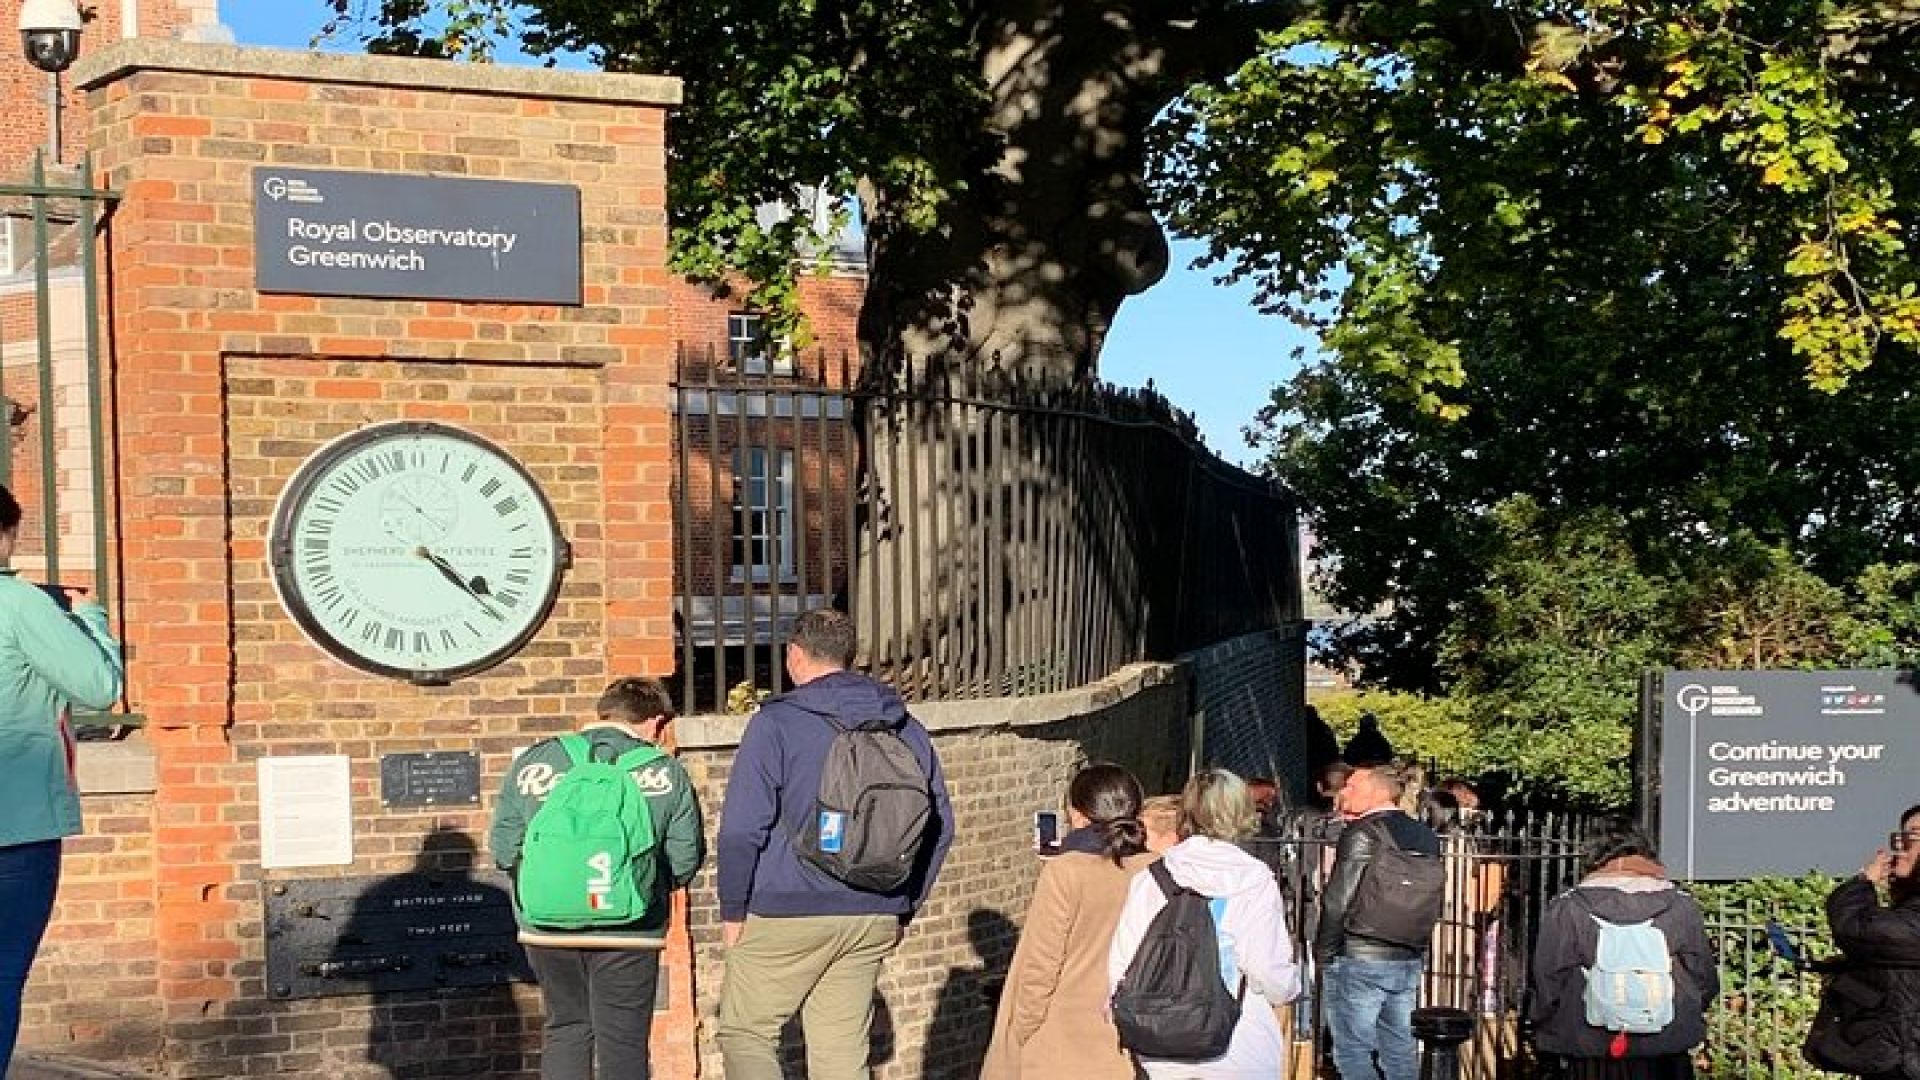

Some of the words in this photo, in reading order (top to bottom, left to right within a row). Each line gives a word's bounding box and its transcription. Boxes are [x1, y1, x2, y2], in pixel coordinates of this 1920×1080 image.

[288, 218, 356, 243] Royal
[363, 221, 516, 252] Observatory
[287, 244, 426, 271] Greenwich
[1708, 740, 1824, 762] Continue
[1828, 744, 1885, 764] your
[1708, 764, 1846, 787] Greenwich
[1707, 791, 1835, 813] adventure
[586, 851, 614, 910] FILA
